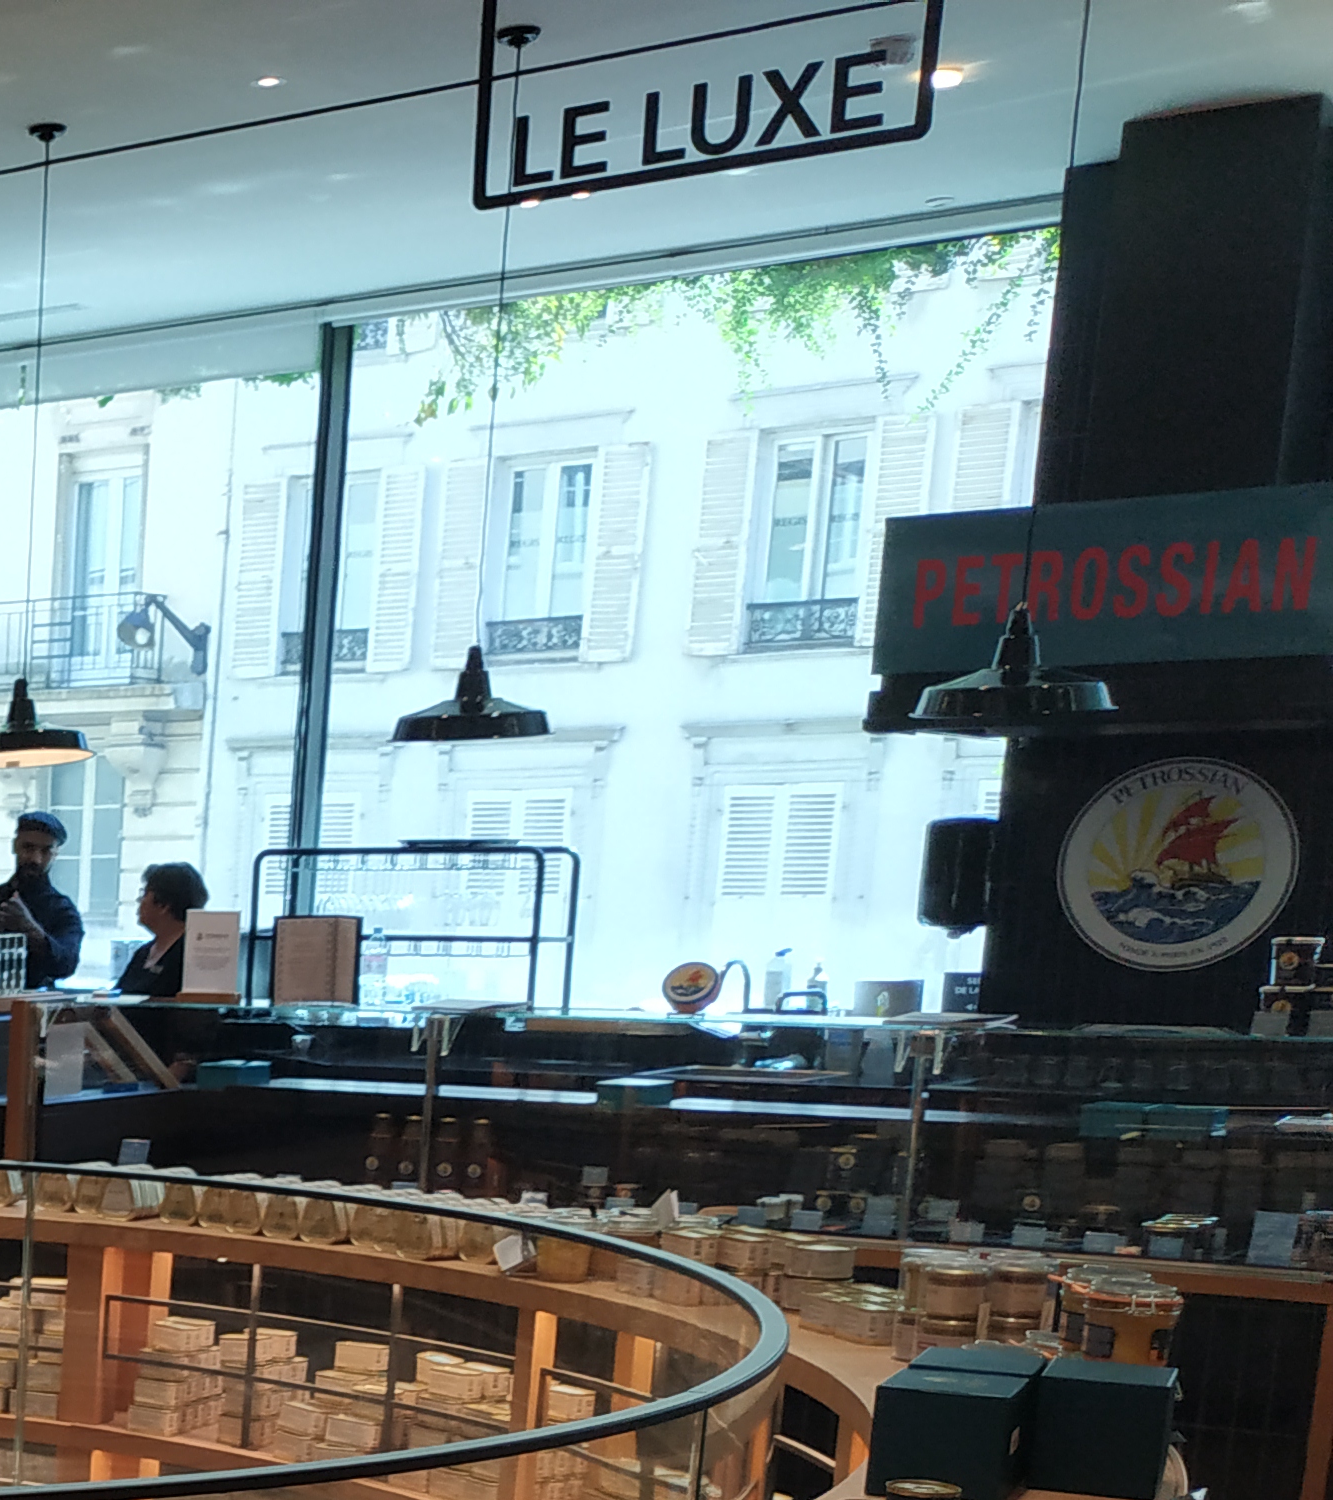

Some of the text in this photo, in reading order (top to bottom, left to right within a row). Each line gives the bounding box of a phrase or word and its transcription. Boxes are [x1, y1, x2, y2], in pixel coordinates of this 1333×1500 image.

[513, 49, 887, 187] LE LUXE
[912, 536, 1319, 629] PETROSSIAN
[1110, 765, 1249, 804] PETROSSIAN
